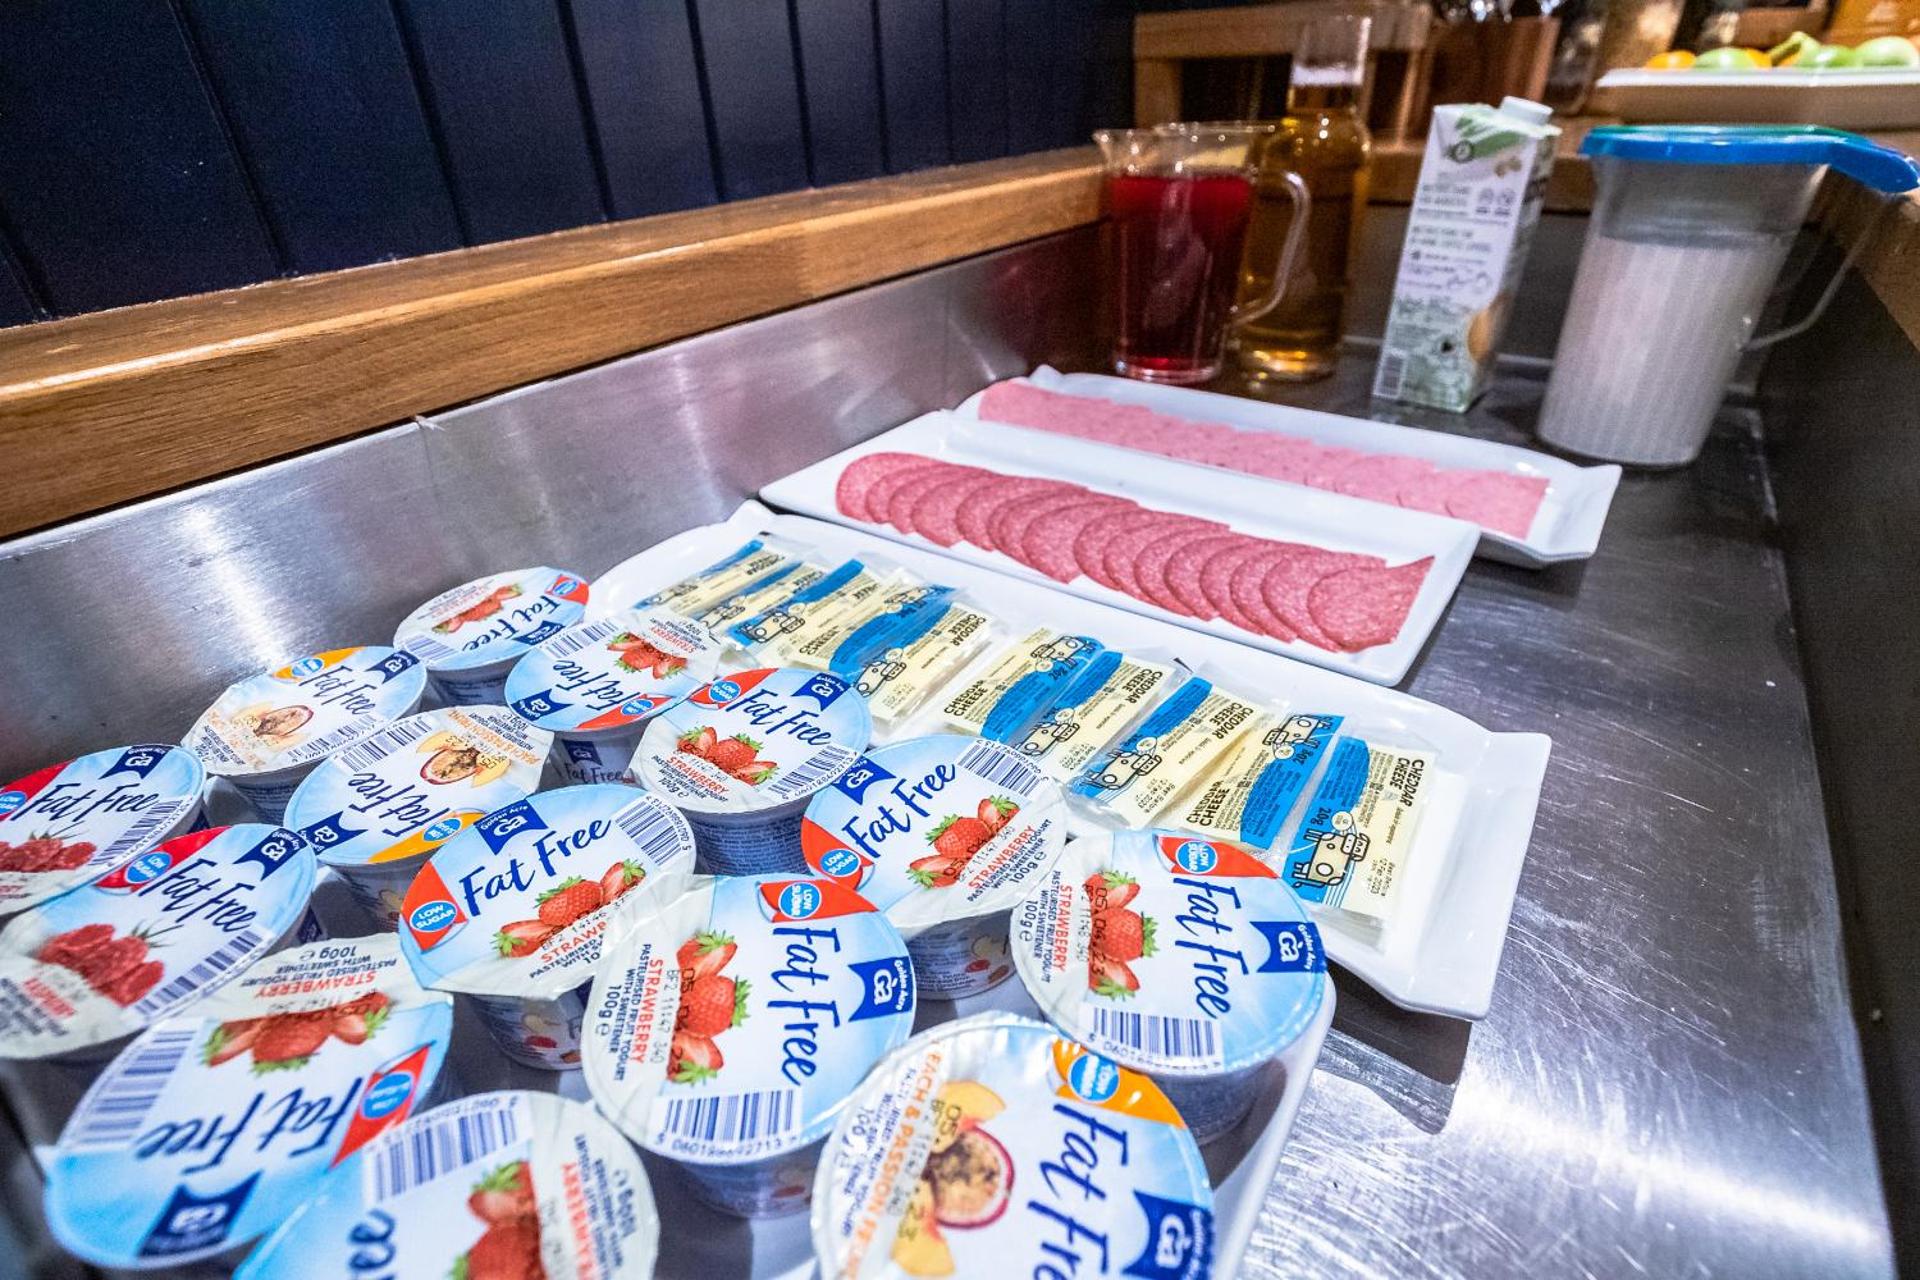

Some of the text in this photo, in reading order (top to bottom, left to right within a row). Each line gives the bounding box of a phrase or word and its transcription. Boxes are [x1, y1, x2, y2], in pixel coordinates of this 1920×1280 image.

[512, 595, 562, 623] Fat
[462, 619, 519, 651] Free
[299, 665, 353, 697] Fat
[553, 660, 609, 691] Free
[1122, 669, 1152, 692] CHEESE
[1126, 672, 1163, 703] CHEDDAR
[321, 684, 377, 715] Free
[581, 680, 641, 711] Fat
[954, 688, 988, 716] CHEESE
[509, 715, 528, 732] 100g
[725, 688, 832, 745] Fat Free
[1210, 703, 1243, 726] CHEESE
[1212, 708, 1253, 739] CHEDDAR
[591, 767, 623, 783] Free
[658, 778, 680, 793] 100g
[666, 756, 729, 794] STRAWBERRY
[1390, 757, 1410, 790] CHEESE
[1400, 759, 1424, 807] CHEDDAR
[10, 783, 97, 821] Fat
[72, 783, 160, 822] Free
[349, 772, 415, 813] Free
[1199, 788, 1230, 826] CHEESE
[378, 794, 450, 838] Fat
[479, 804, 528, 831] Golden Acre
[841, 807, 911, 859] Fat
[891, 763, 956, 818] Free
[1310, 808, 1331, 825] 20g
[458, 819, 611, 917] Fat Free
[823, 852, 844, 867] LOW
[828, 855, 857, 875] SUGAR
[967, 818, 1053, 902] PASTEURISED FRUIT YOGURT
[968, 825, 1035, 889] STRAWBERRY
[991, 838, 1046, 889] WITH SWEETENER
[1200, 843, 1211, 868] LOW
[1009, 861, 1039, 884] 100g
[138, 858, 257, 932] Fat Free
[417, 904, 445, 919] LOW
[803, 889, 813, 911] LOW
[1049, 870, 1061, 925] PASTEURISED
[416, 909, 456, 929] SUGAR
[1019, 900, 1038, 930] 100g
[1034, 889, 1049, 960] WITH SWEETENER
[1053, 884, 1073, 972] STRAWBERRY
[1091, 886, 1109, 976] 05.04.23
[317, 943, 357, 961] 100g
[1047, 928, 1057, 951] FRUIT
[1172, 877, 1249, 1019] Fat Free
[274, 954, 371, 976] WITH SWEETENER
[529, 938, 596, 978] PASTEURISED
[562, 949, 591, 969] WITH
[632, 943, 651, 1005] PASTEURISED
[256, 970, 376, 998] STRAWBERRY
[893, 959, 910, 1011] Golden Acre
[599, 985, 621, 1018] 100g
[609, 968, 636, 1053] WITH SWEETENER
[631, 959, 663, 1064] STRAWBERRY
[650, 969, 679, 1064] BF2 11:47 340
[767, 927, 841, 1086] Fat Free
[626, 1008, 638, 1035] FRUIT
[135, 1092, 263, 1175] Free
[258, 1077, 363, 1158] Fat
[866, 1039, 941, 1213] EACH & PASSION
[1039, 1104, 1128, 1199] Fat
